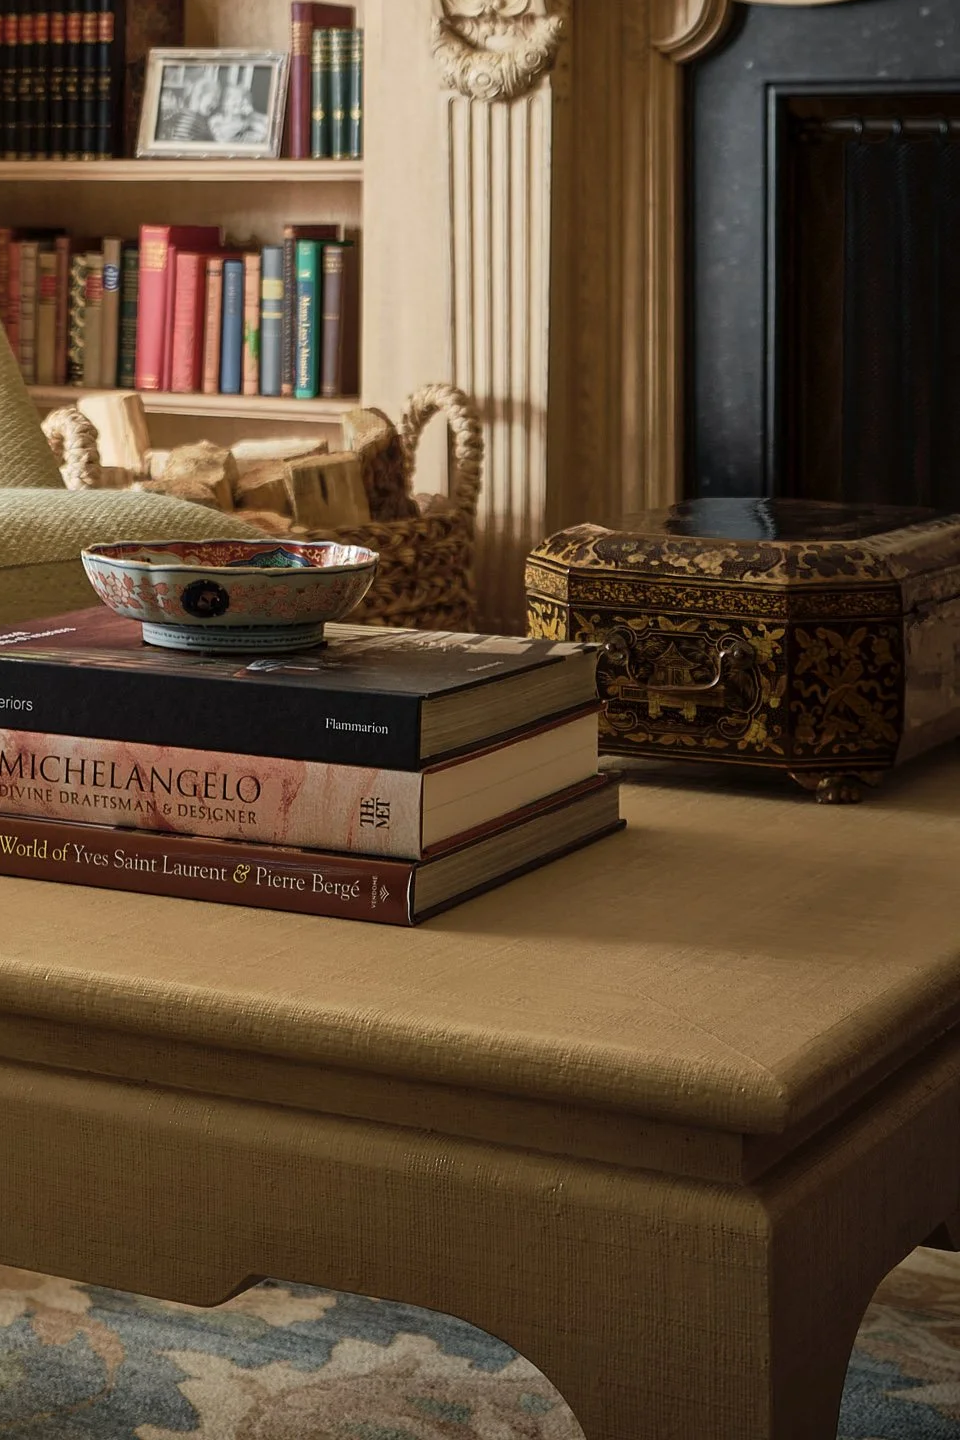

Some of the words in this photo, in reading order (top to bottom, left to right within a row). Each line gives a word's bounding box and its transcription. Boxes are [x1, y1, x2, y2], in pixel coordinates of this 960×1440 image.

[325, 717, 389, 735] Flammarion
[59, 790, 157, 814] DRAFTSMAN
[162, 803, 172, 815] &
[178, 804, 257, 825] DESIGNER
[360, 797, 375, 828] THE
[375, 797, 390, 830] MET
[52, 842, 70, 861] of
[73, 844, 109, 866] Yves
[113, 849, 157, 873] Saint
[162, 855, 228, 882] Laurent
[233, 864, 251, 884] &
[256, 866, 305, 891] Pierre
[312, 873, 360, 901] Bergé
